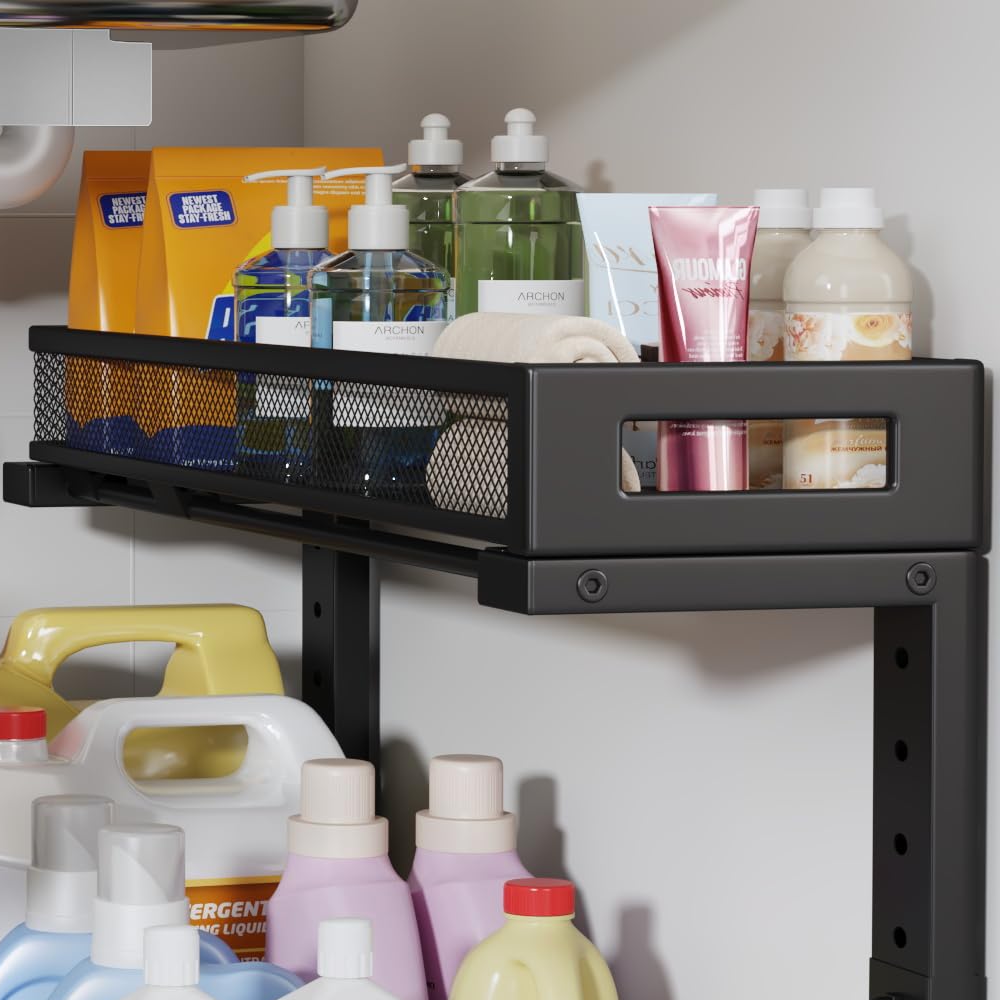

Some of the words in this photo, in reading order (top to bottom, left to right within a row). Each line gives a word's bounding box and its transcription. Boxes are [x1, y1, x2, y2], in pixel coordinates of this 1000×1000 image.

[181, 194, 218, 206] NEWEST
[112, 204, 145, 215] PACKAG
[182, 203, 224, 214] PACKAGE
[108, 212, 144, 224] STAY-FR
[178, 211, 231, 224] STAY-FRESH
[517, 291, 565, 301] ARCHON
[374, 325, 425, 335] ARCHON
[799, 473, 813, 484] 51
[189, 900, 269, 920] ERGENT
